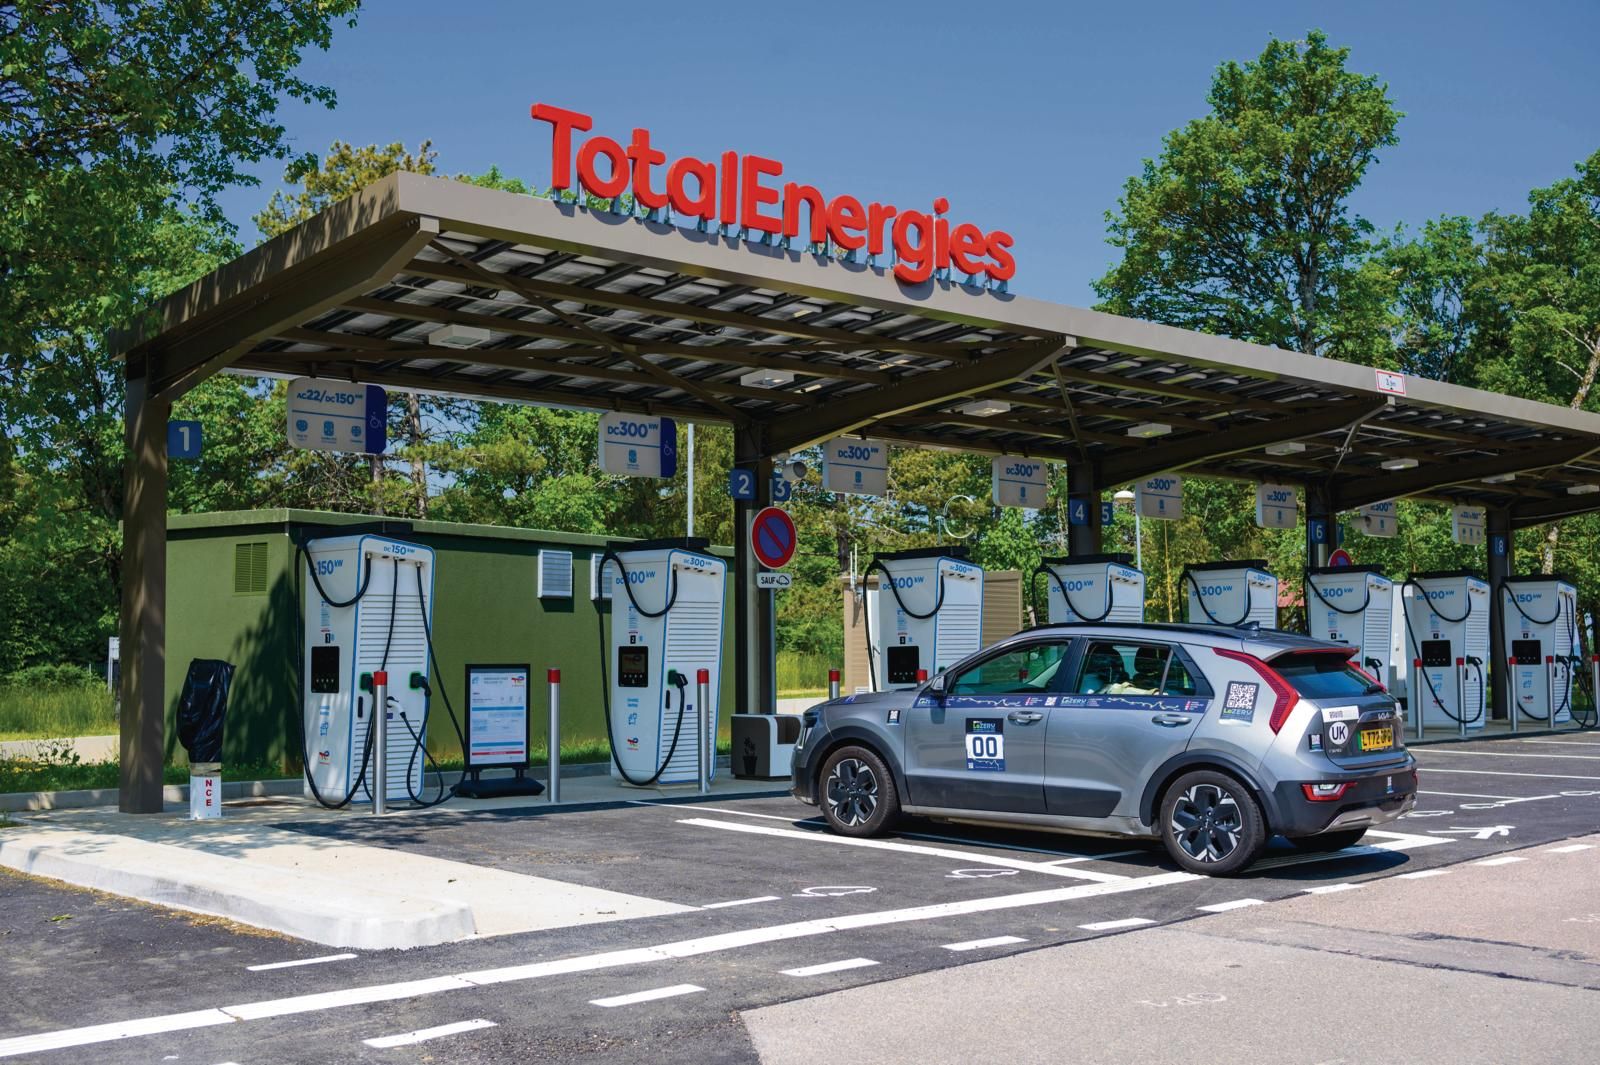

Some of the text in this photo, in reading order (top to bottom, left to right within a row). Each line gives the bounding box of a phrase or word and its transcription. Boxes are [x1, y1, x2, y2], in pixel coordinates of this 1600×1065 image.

[531, 103, 1015, 284] TotalEnergies
[178, 426, 190, 452] 1
[738, 474, 750, 494] 2
[774, 478, 786, 497] 3
[1075, 504, 1085, 521] 4
[1101, 505, 1110, 522] 5
[1316, 524, 1323, 539] 6
[760, 576, 776, 585] SAUF
[1332, 726, 1346, 740] UK
[973, 736, 998, 757] 00
[205, 779, 213, 807] NCE
